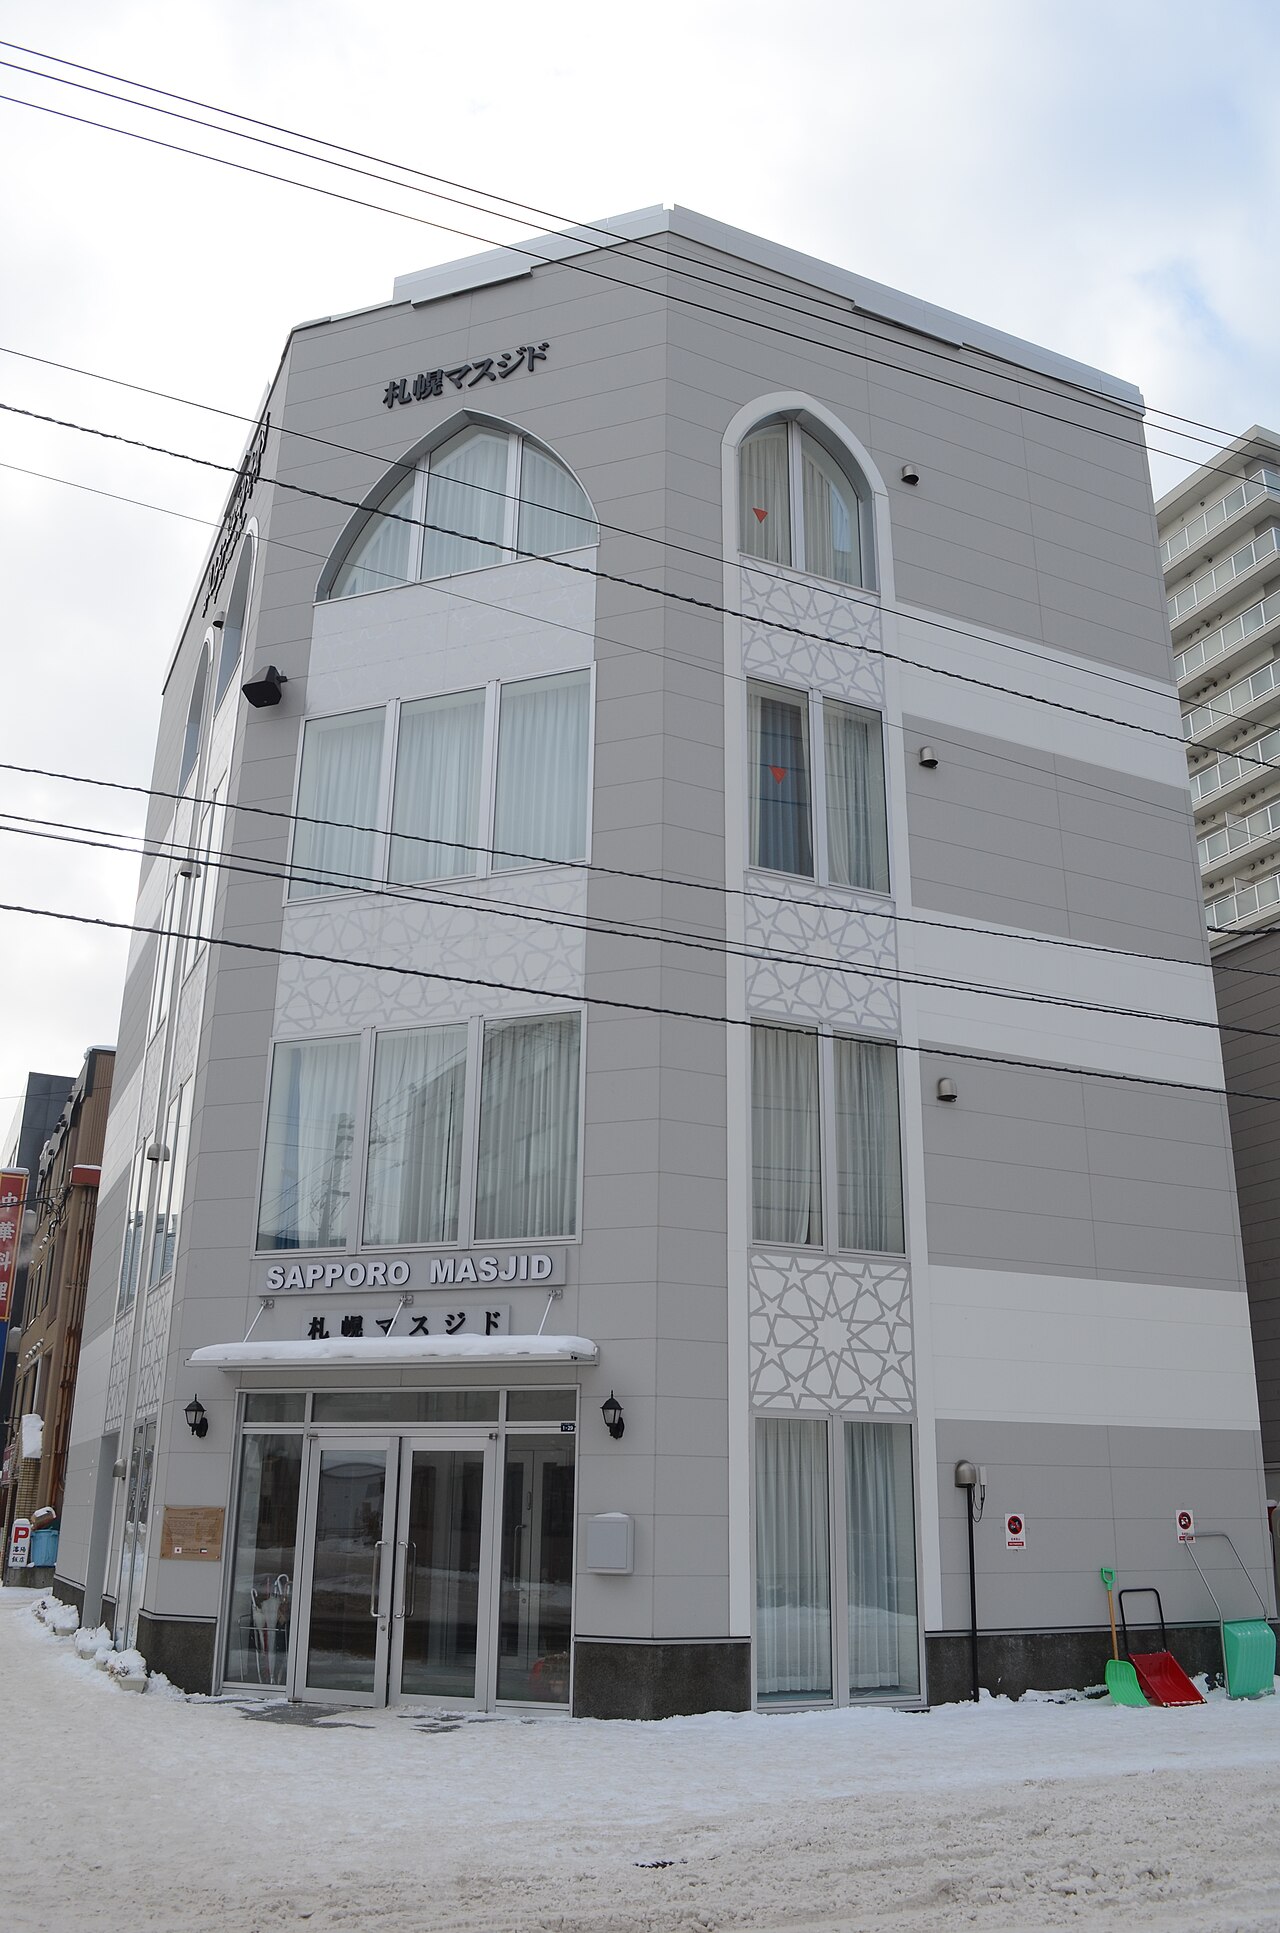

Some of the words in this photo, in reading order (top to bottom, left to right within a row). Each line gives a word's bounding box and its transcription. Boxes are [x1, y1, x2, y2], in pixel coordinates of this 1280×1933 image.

[383, 342, 550, 409] 札幌マスジド
[265, 1260, 411, 1290] SAPPORO
[429, 1254, 553, 1284] MASJID
[307, 1311, 501, 1340] 札幌マスジド
[13, 1527, 29, 1543] P
